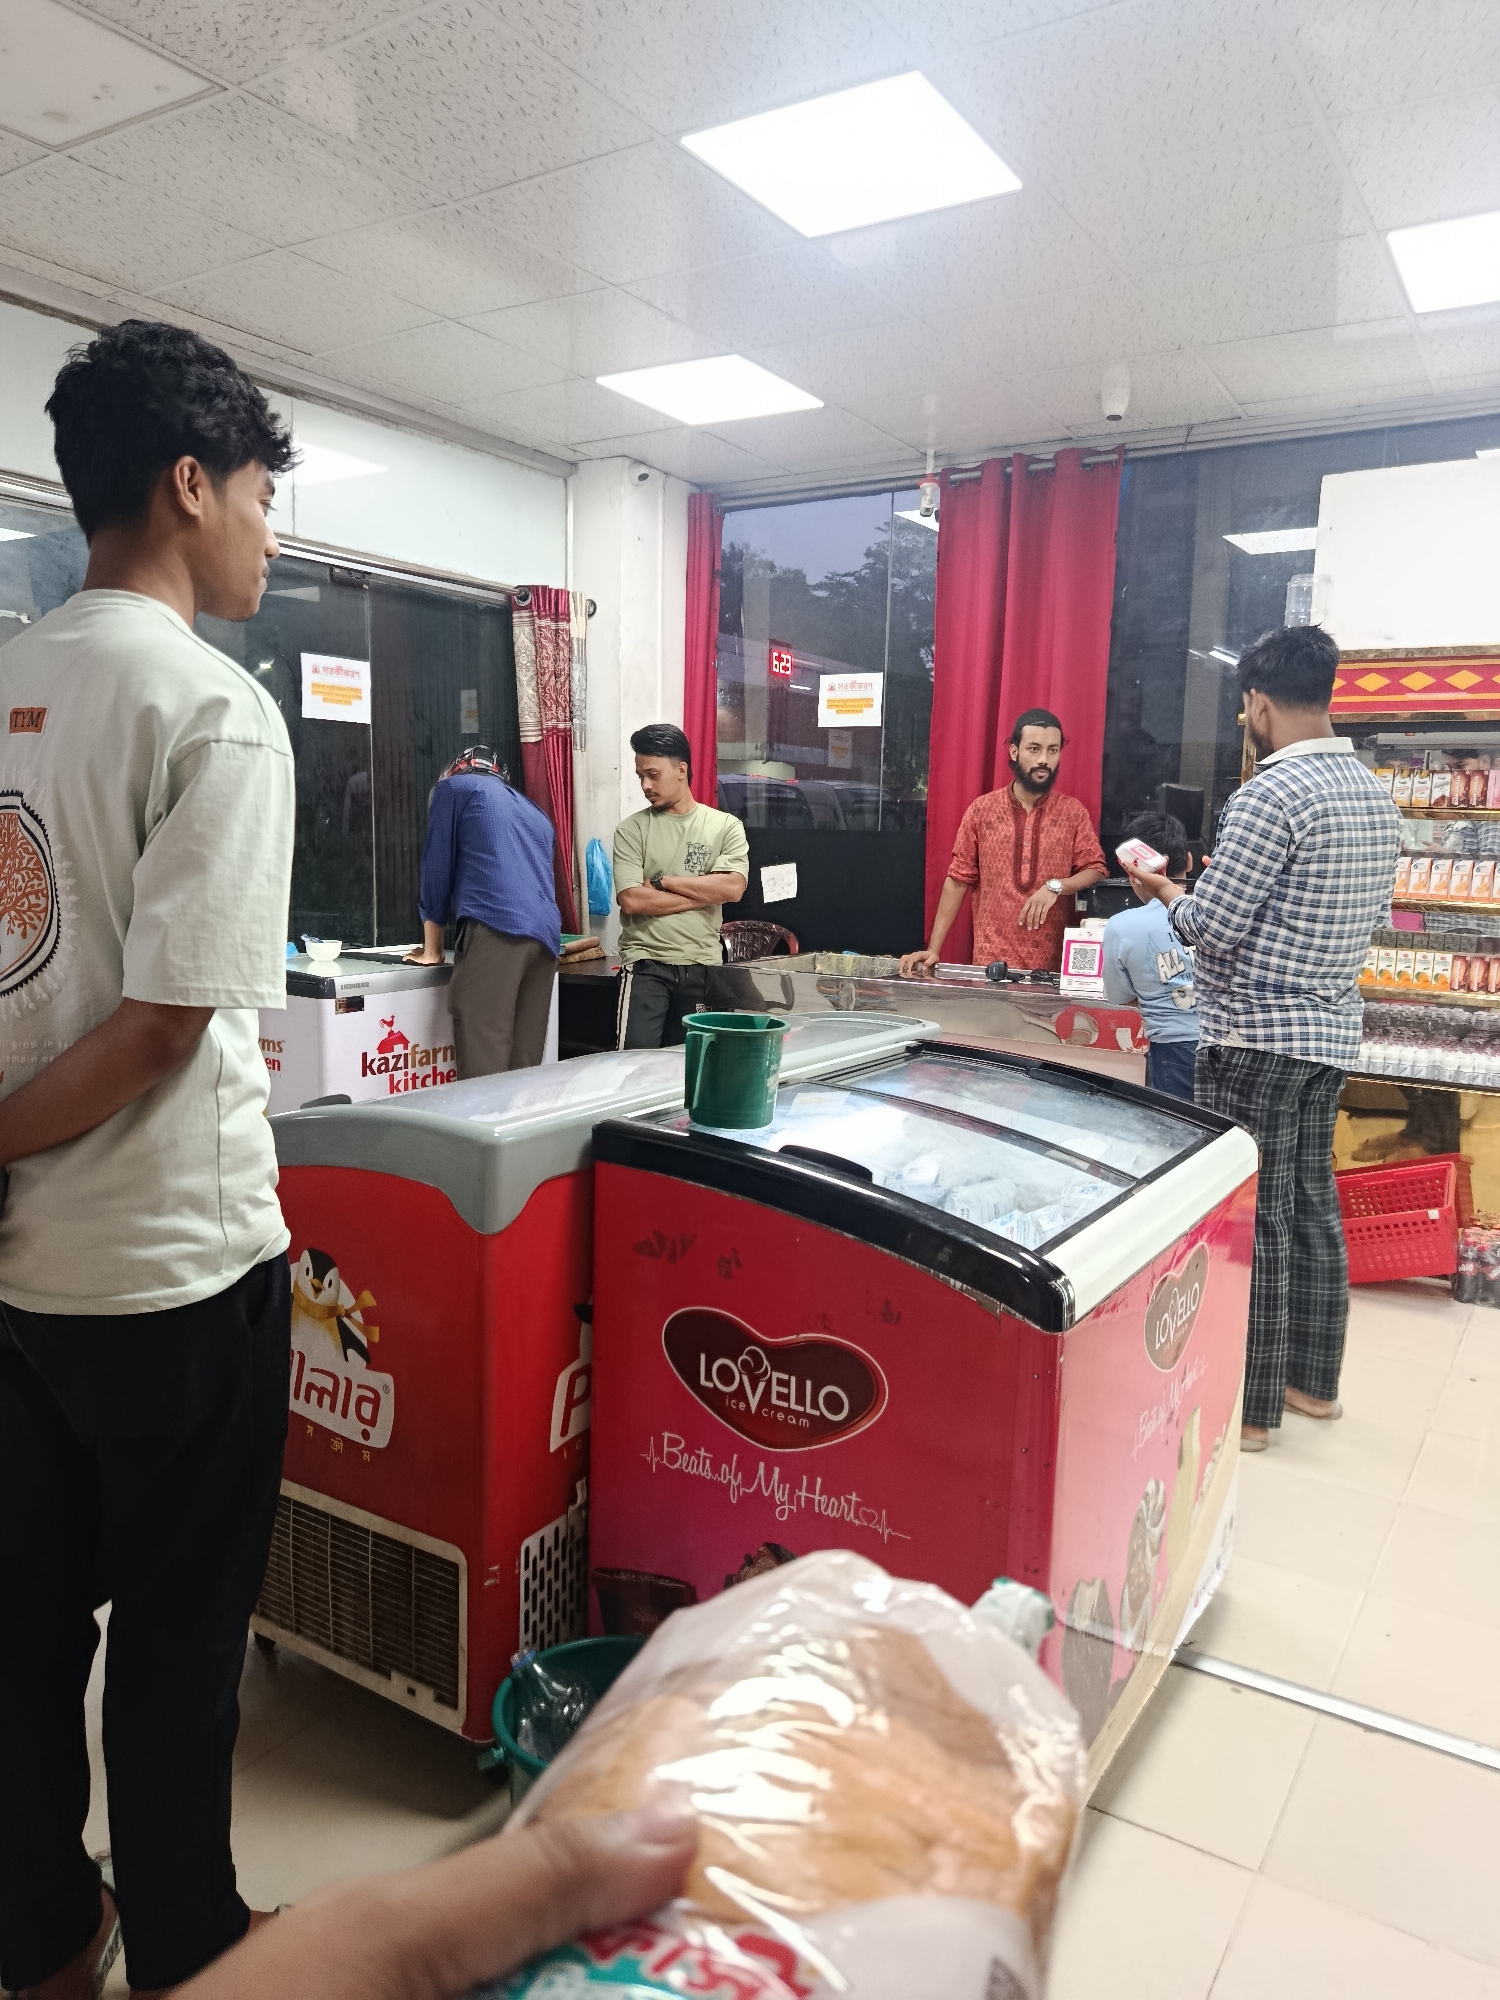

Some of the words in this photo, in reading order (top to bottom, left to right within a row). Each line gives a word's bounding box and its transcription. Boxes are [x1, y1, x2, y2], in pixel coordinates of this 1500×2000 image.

[13, 711, 42, 728] TYM
[1156, 948, 1186, 985] ALL
[362, 1044, 456, 1077] kazifarm
[389, 1066, 457, 1095] kitche
[1155, 1282, 1200, 1350] LOVELLO
[700, 1347, 849, 1421] LOVELLO
[726, 1396, 746, 1411] ice
[762, 1408, 810, 1428] cream
[662, 1431, 712, 1479] Beats
[720, 1454, 738, 1503] of
[752, 1462, 790, 1521] My
[796, 1475, 861, 1523] Heart
